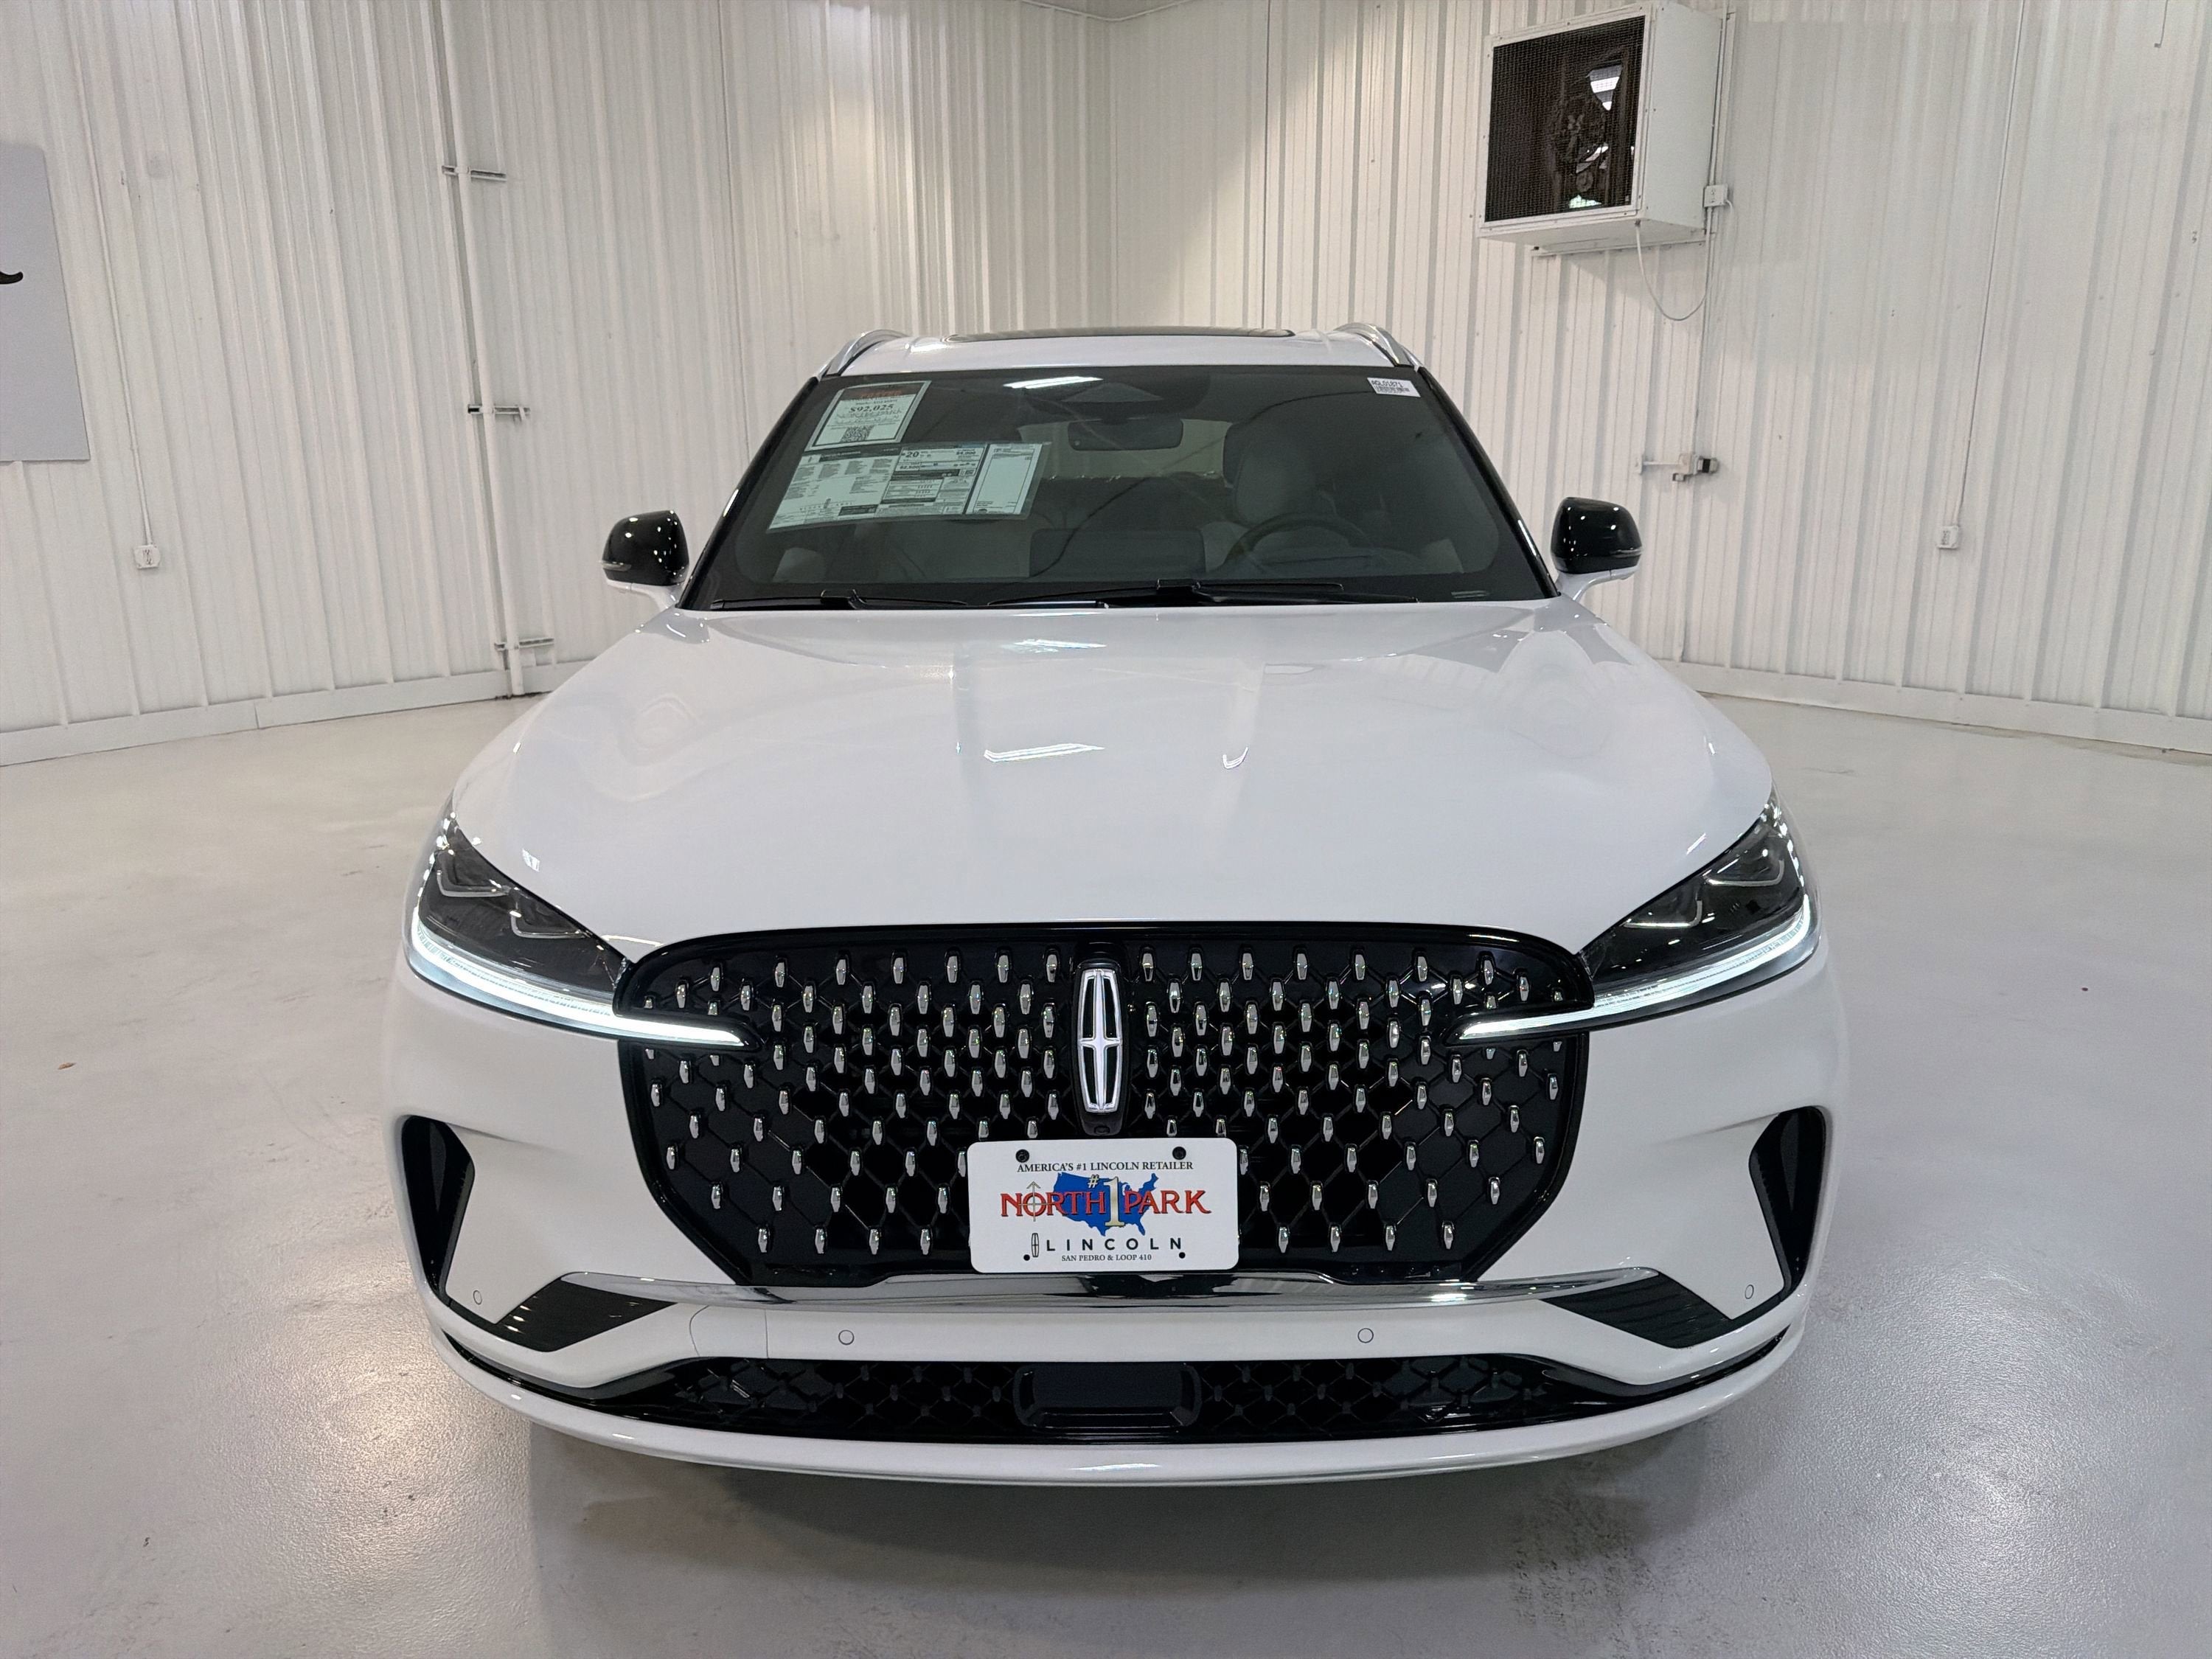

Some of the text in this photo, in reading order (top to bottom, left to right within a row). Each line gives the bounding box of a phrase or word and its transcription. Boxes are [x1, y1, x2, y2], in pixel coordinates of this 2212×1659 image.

[850, 403, 894, 412] $92,025
[1017, 1161, 1194, 1172] AMERICA'S #1 LINCOLN RETAILER
[1000, 1190, 1212, 1217] NORTH PARK
[1046, 1237, 1181, 1251] LINCOLN
